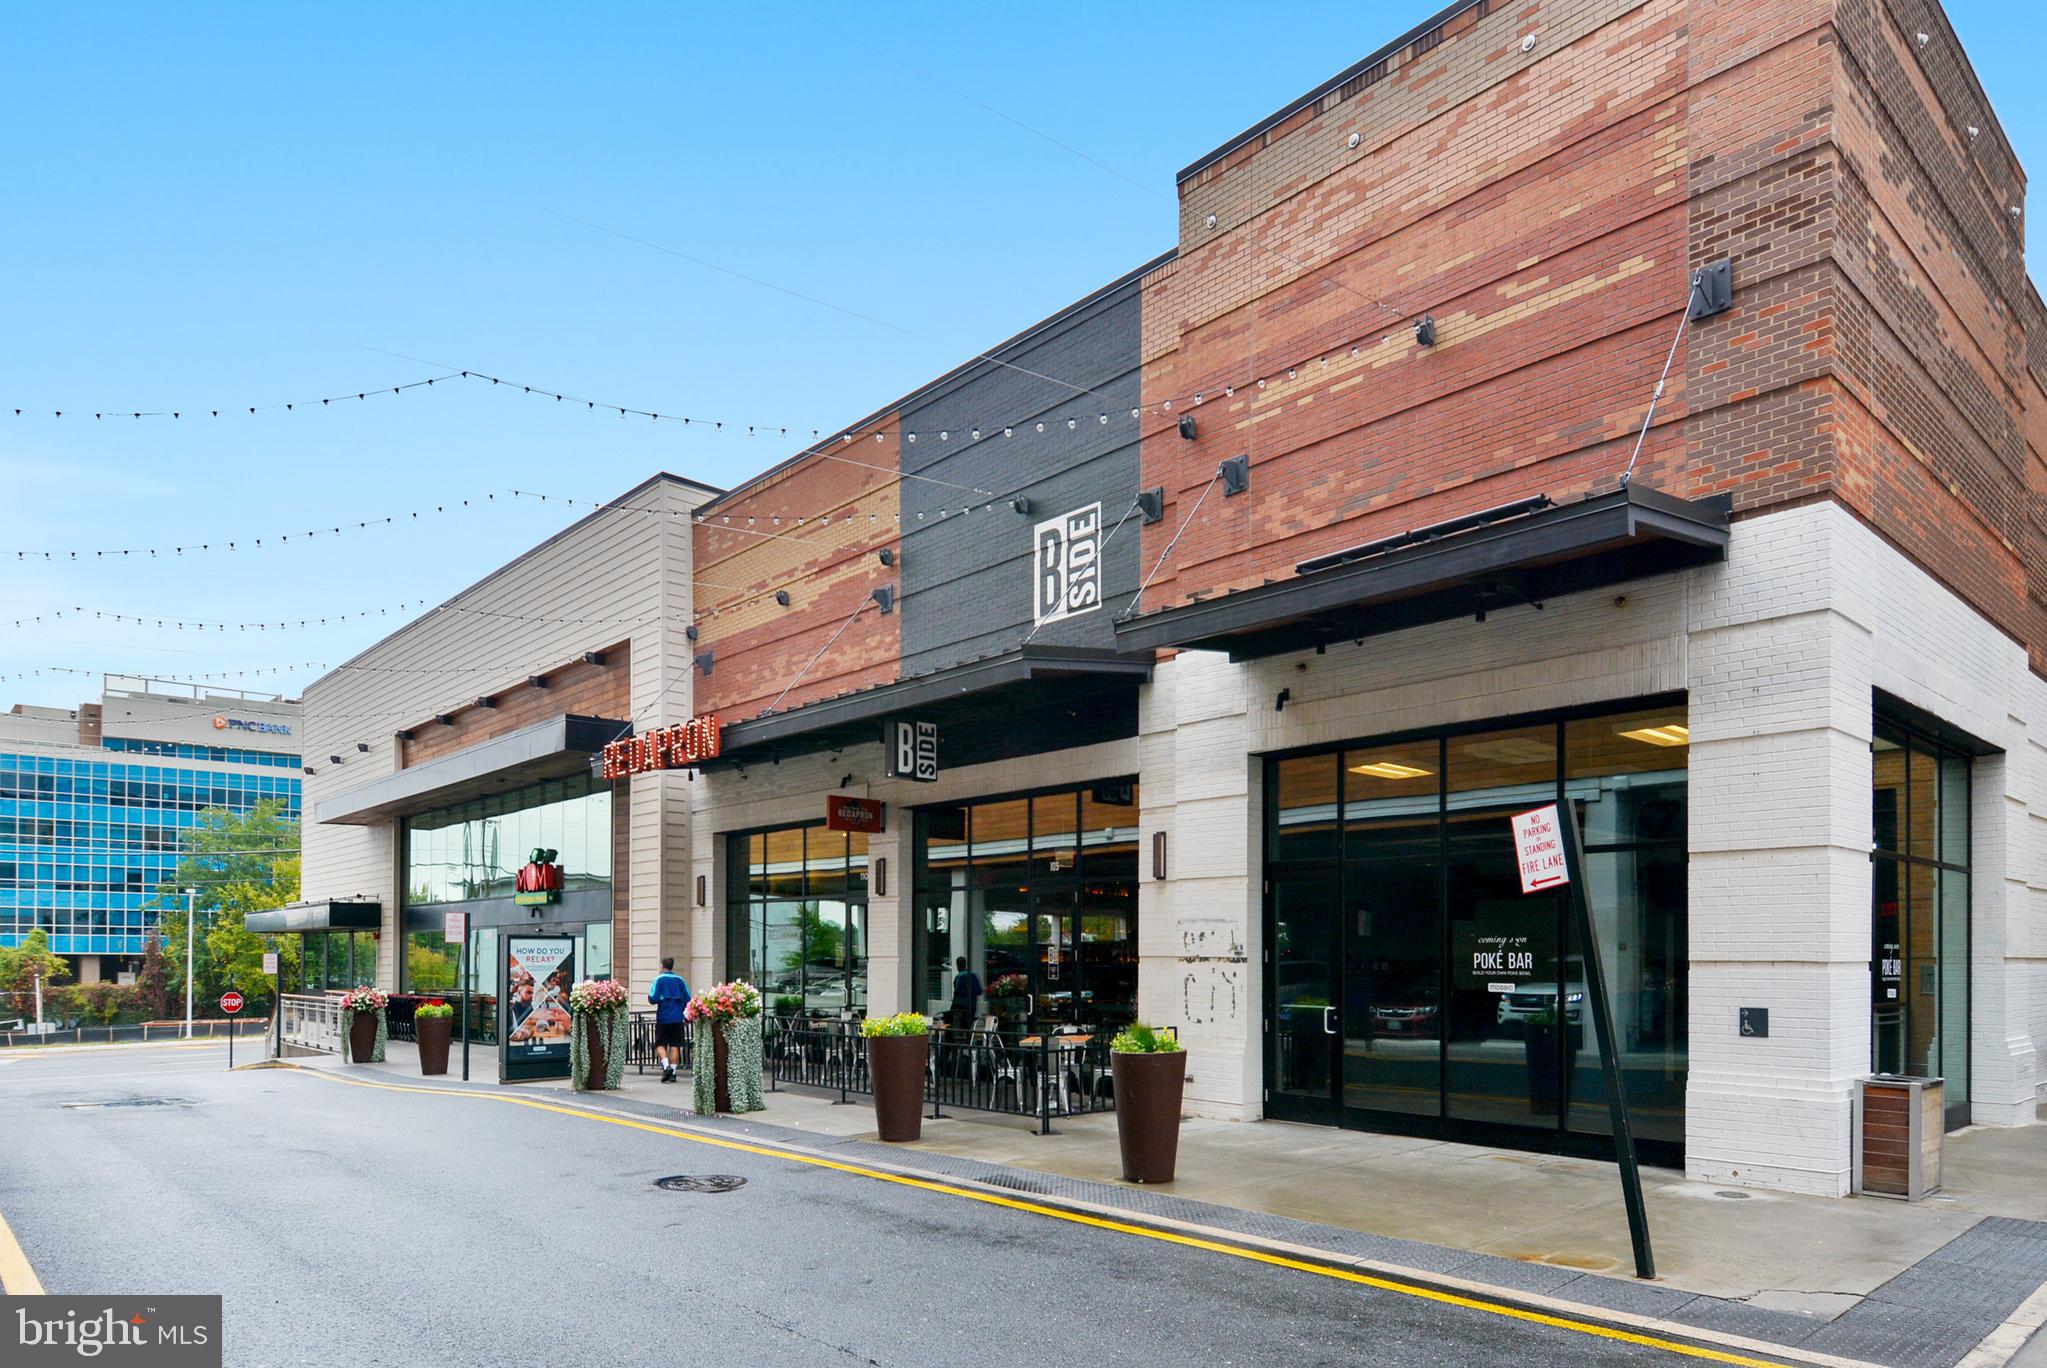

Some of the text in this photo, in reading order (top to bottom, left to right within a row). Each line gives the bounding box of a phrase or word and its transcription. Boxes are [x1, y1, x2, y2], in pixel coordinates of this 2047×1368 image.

[1040, 512, 1096, 616] B SIDE
[228, 719, 292, 735] PNC BANK
[898, 722, 936, 776] B SIDE
[1530, 814, 1540, 825] NO
[1523, 822, 1552, 838] PARKING
[1524, 840, 1556, 857] STANDING
[1522, 853, 1564, 875] FIRE LANE
[526, 955, 555, 963] RELAX?
[1473, 949, 1533, 969] POKÉ BAR
[223, 998, 241, 1006] STOP
